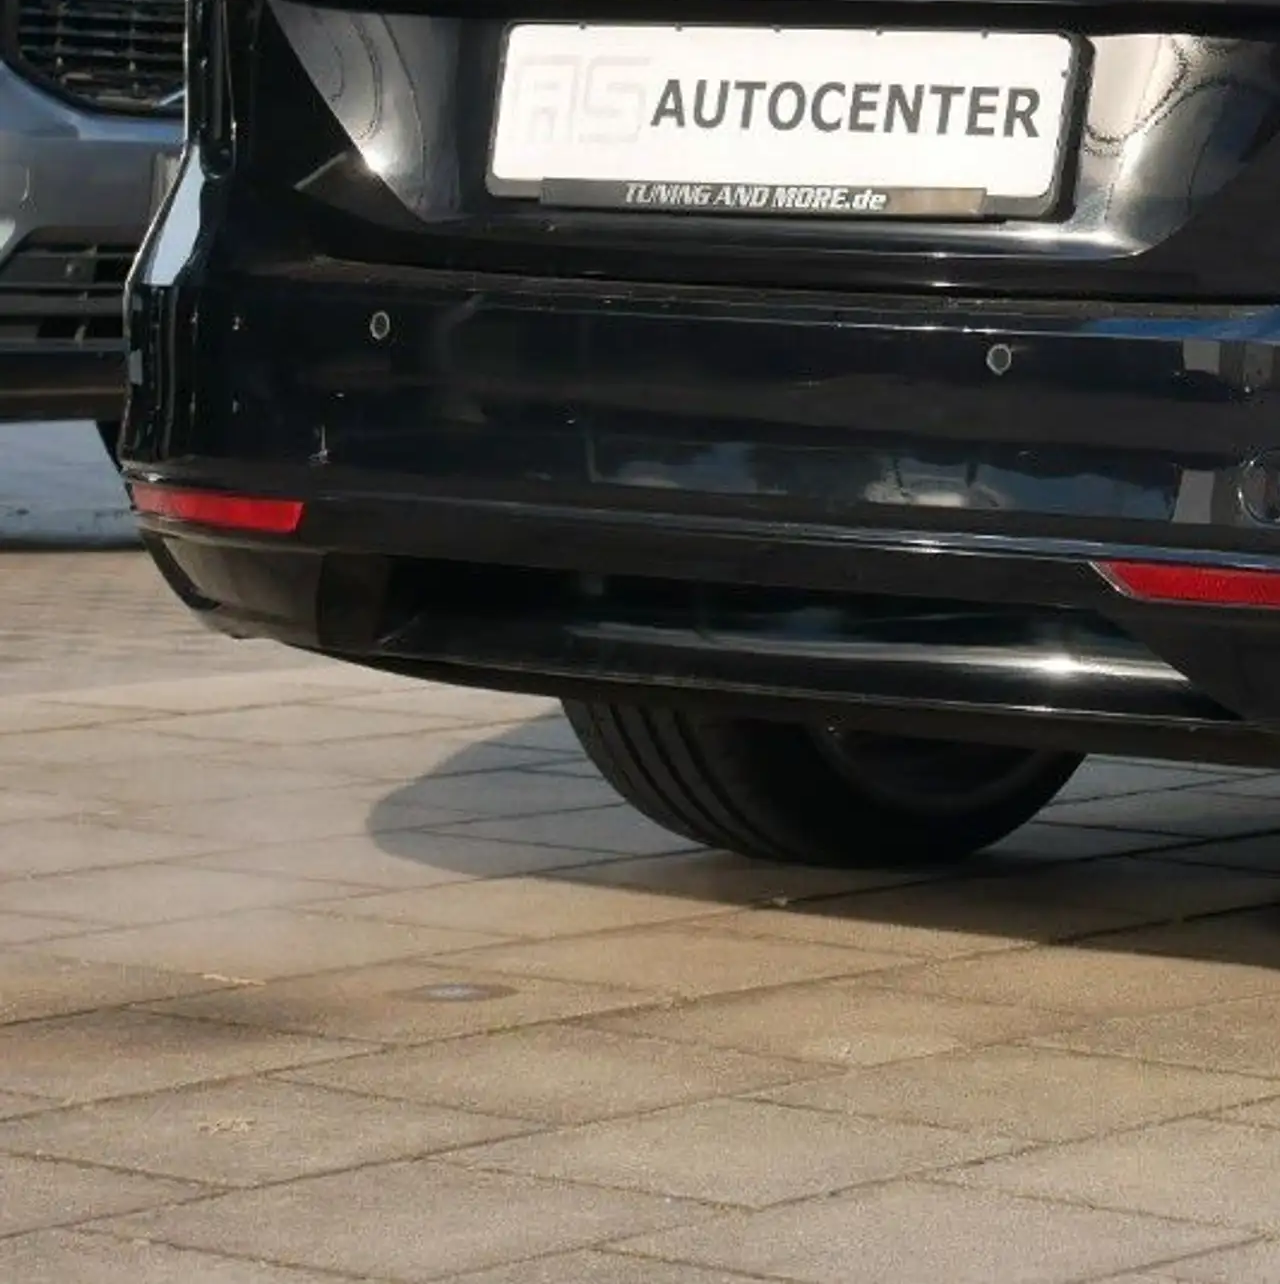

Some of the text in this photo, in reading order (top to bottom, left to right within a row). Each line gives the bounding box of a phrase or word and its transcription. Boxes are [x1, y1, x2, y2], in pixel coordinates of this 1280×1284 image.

[649, 76, 1042, 140] AUTOCENTER
[624, 181, 888, 211] TUNING AND MORE.de
